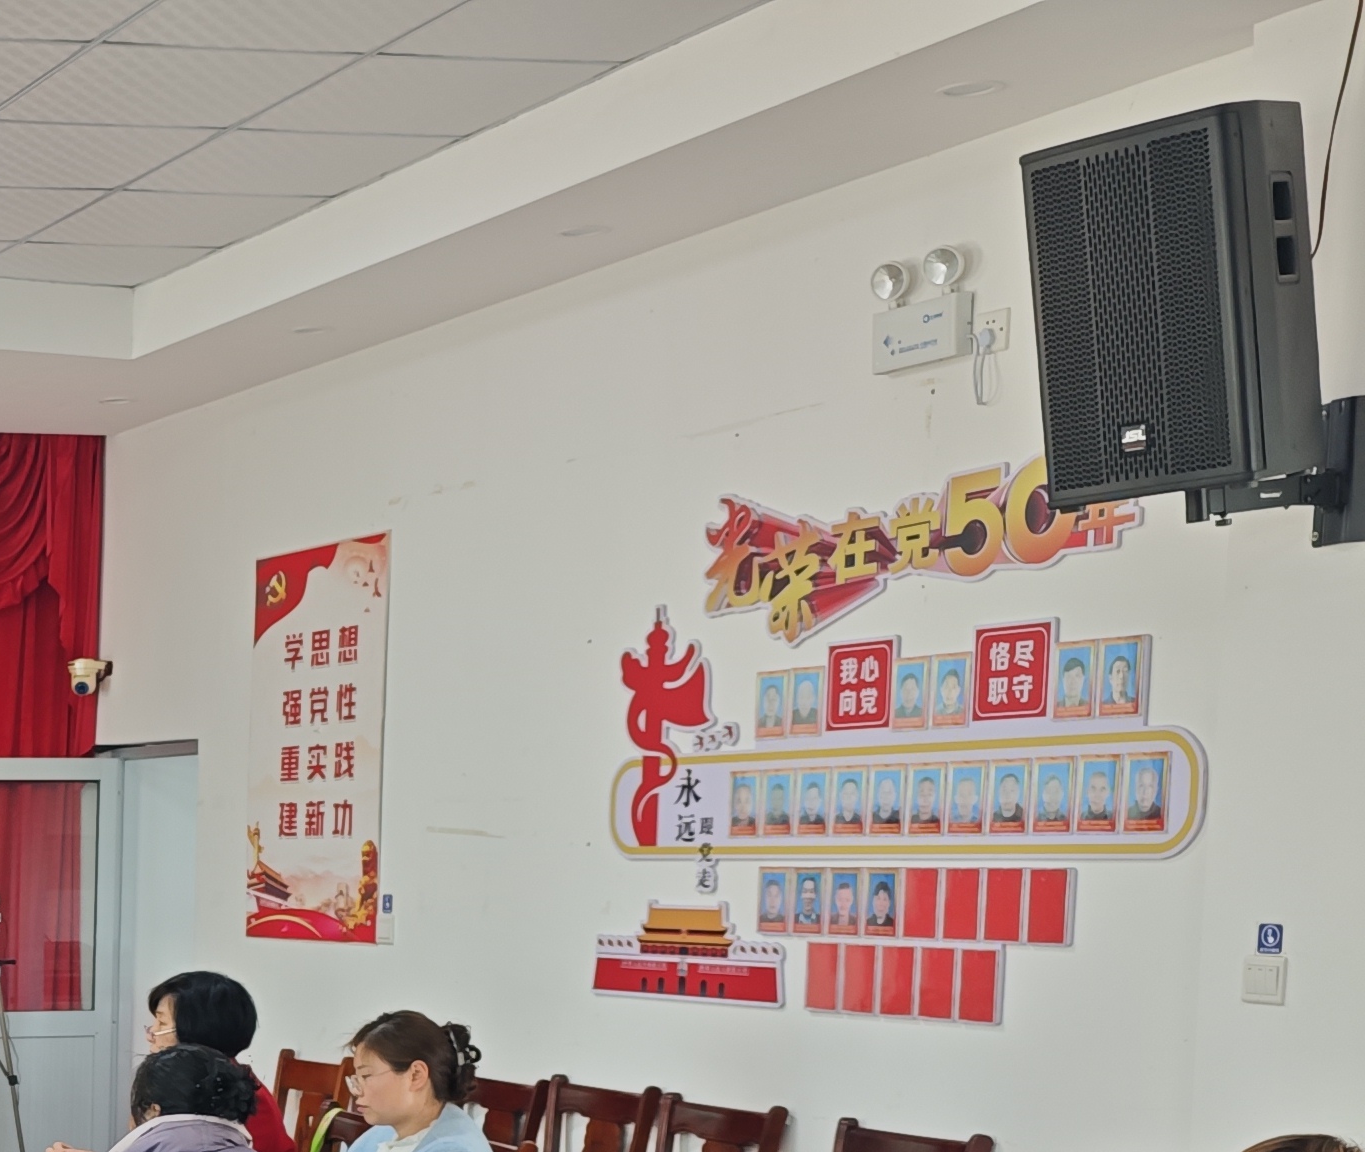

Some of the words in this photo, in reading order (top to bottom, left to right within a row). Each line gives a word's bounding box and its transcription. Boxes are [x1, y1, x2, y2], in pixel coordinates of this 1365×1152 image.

[283, 624, 360, 671] 学思想
[989, 639, 1035, 672] 恪尽
[839, 655, 880, 685] 我心
[986, 674, 1034, 705] 职守
[281, 683, 358, 727] 强党性
[838, 687, 878, 717] 向党
[279, 741, 356, 783] 重实践
[277, 799, 354, 839] 建新功
[674, 768, 702, 843] 永远
